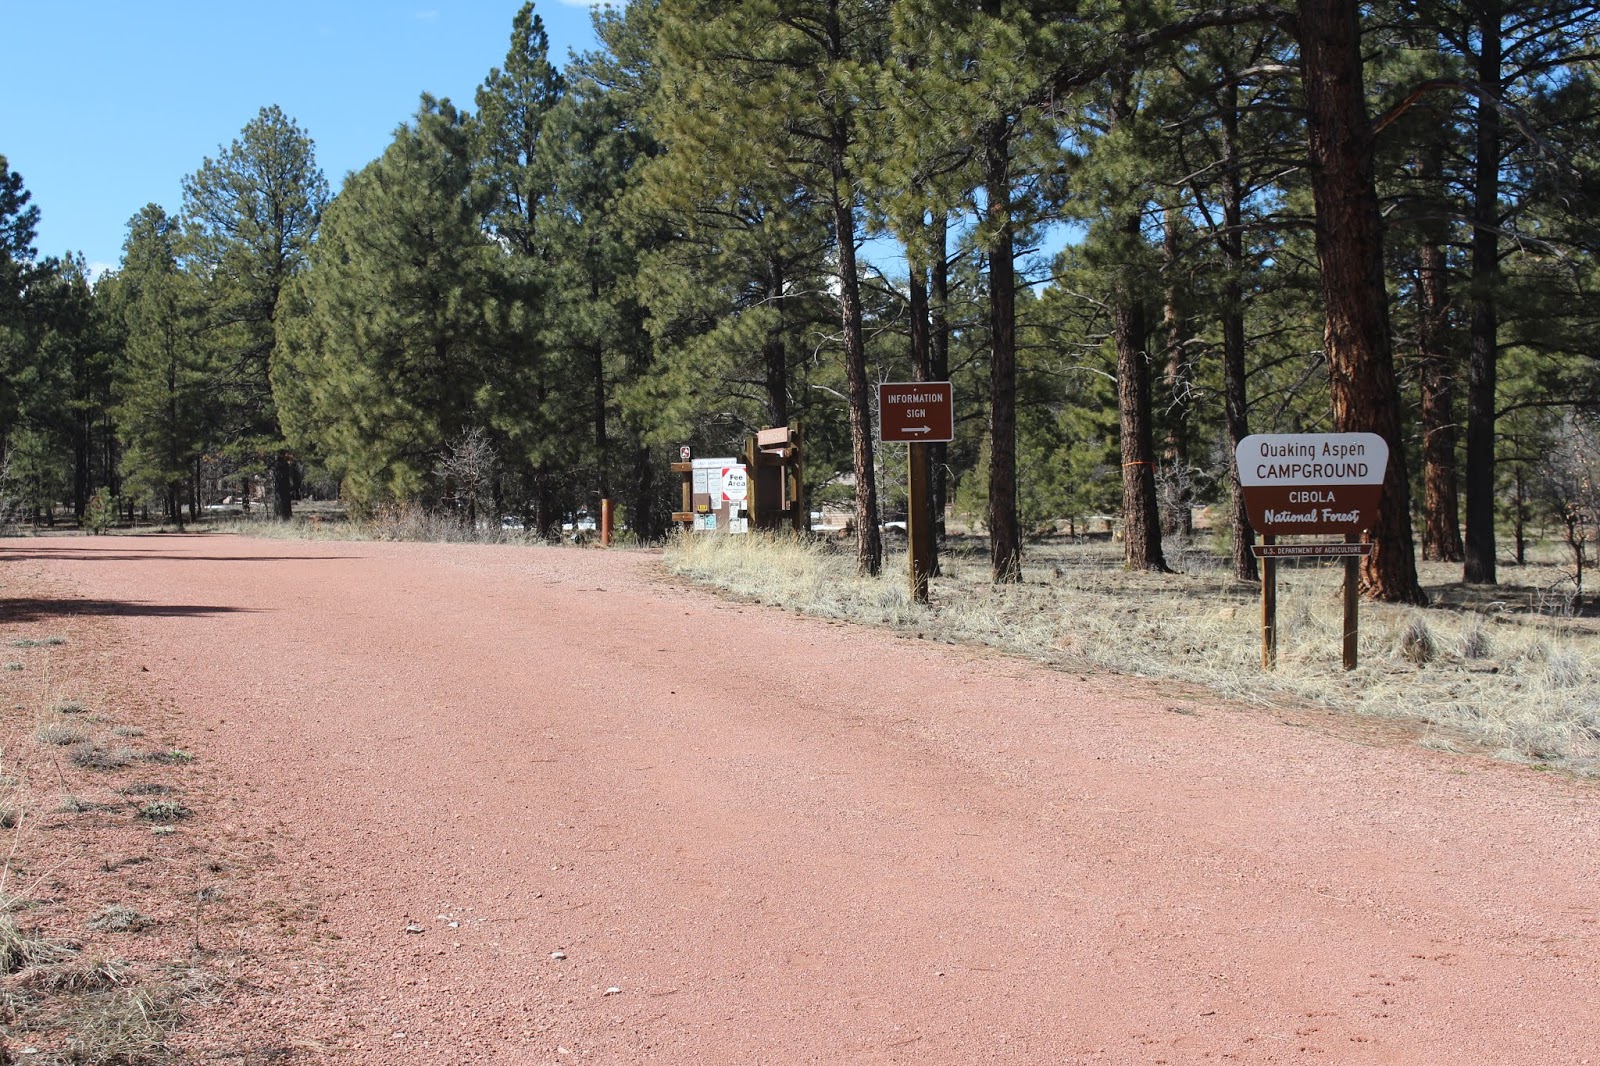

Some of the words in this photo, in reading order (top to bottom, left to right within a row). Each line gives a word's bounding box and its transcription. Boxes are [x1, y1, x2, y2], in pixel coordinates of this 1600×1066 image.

[888, 393, 943, 404] INFORMATION
[906, 408, 926, 418] SIGN
[1260, 442, 1315, 461] Quaking
[1322, 442, 1365, 459] Aspen
[1257, 463, 1368, 479] CAMPGROUND
[1289, 491, 1336, 503] CIBOLA
[1264, 509, 1318, 524] National
[1321, 508, 1360, 523] Forest
[1277, 547, 1313, 555] DEPARTMENT
[1324, 546, 1362, 554] AGRICULTURE
